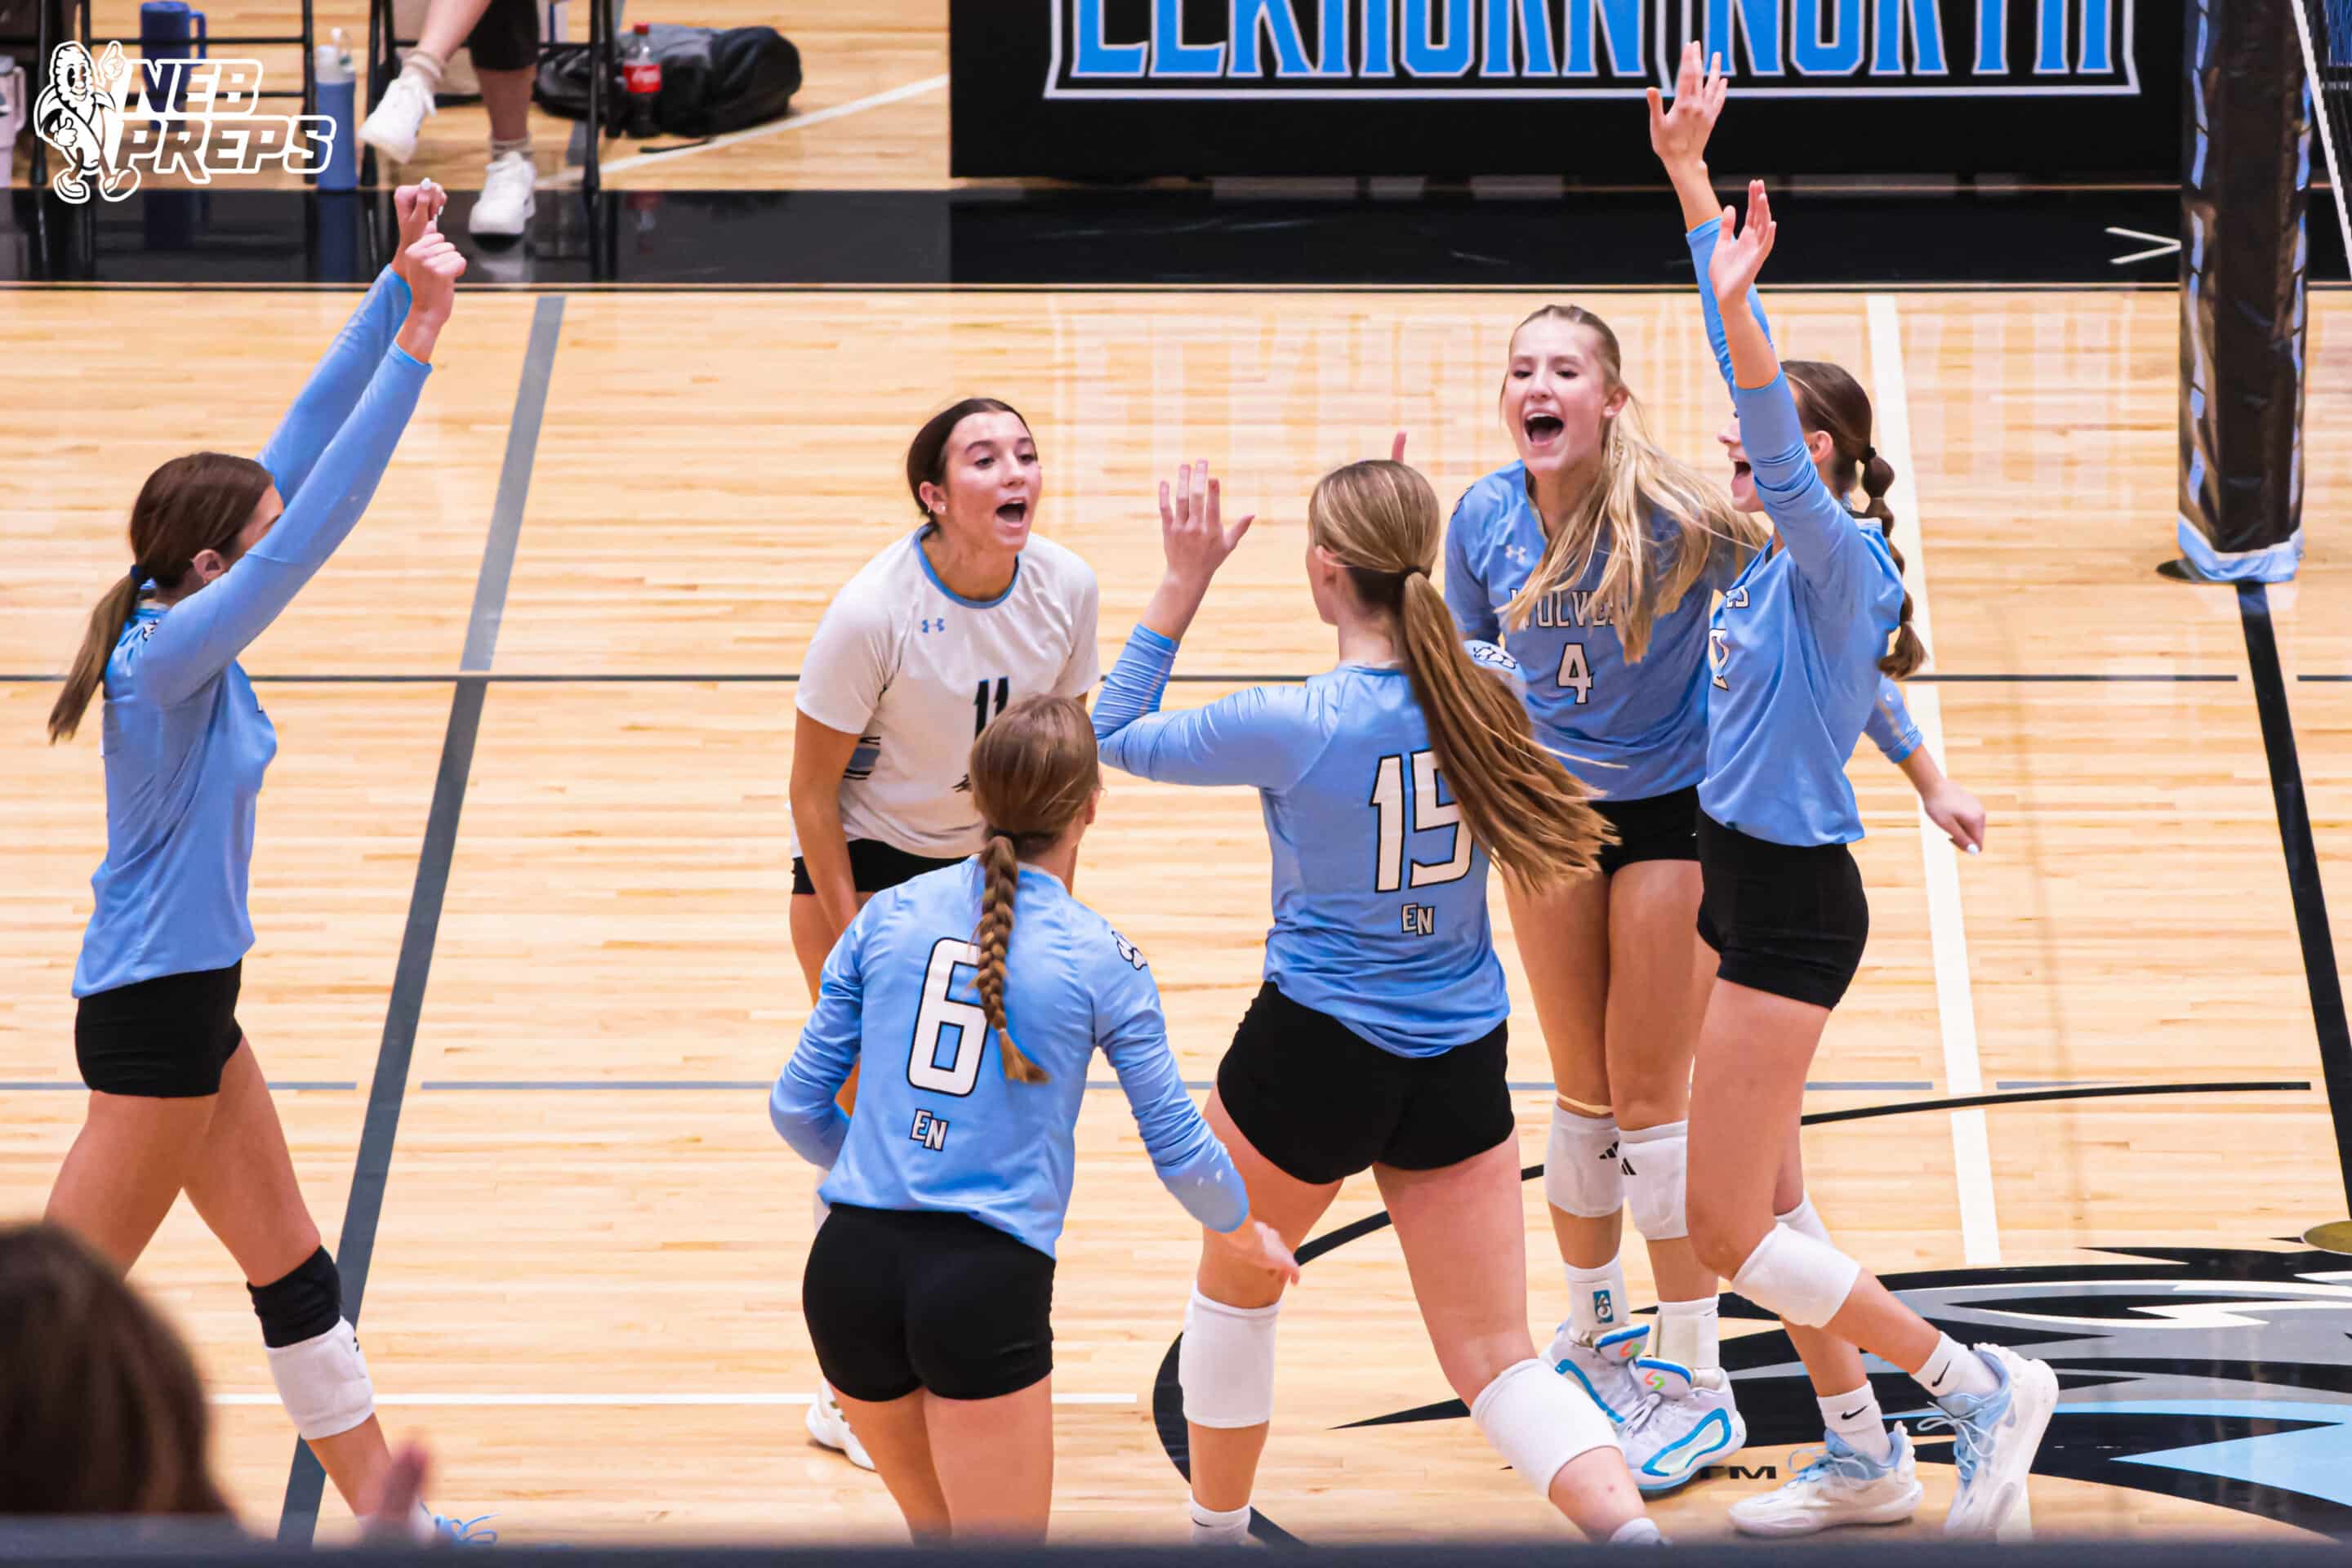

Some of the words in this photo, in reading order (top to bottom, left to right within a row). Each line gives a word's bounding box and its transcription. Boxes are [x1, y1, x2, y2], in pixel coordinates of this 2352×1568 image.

[1557, 642, 1596, 705] 4
[1369, 748, 1474, 893] 15
[1401, 902, 1437, 936] EN
[906, 938, 990, 1098] 6
[909, 1107, 949, 1152] EN
